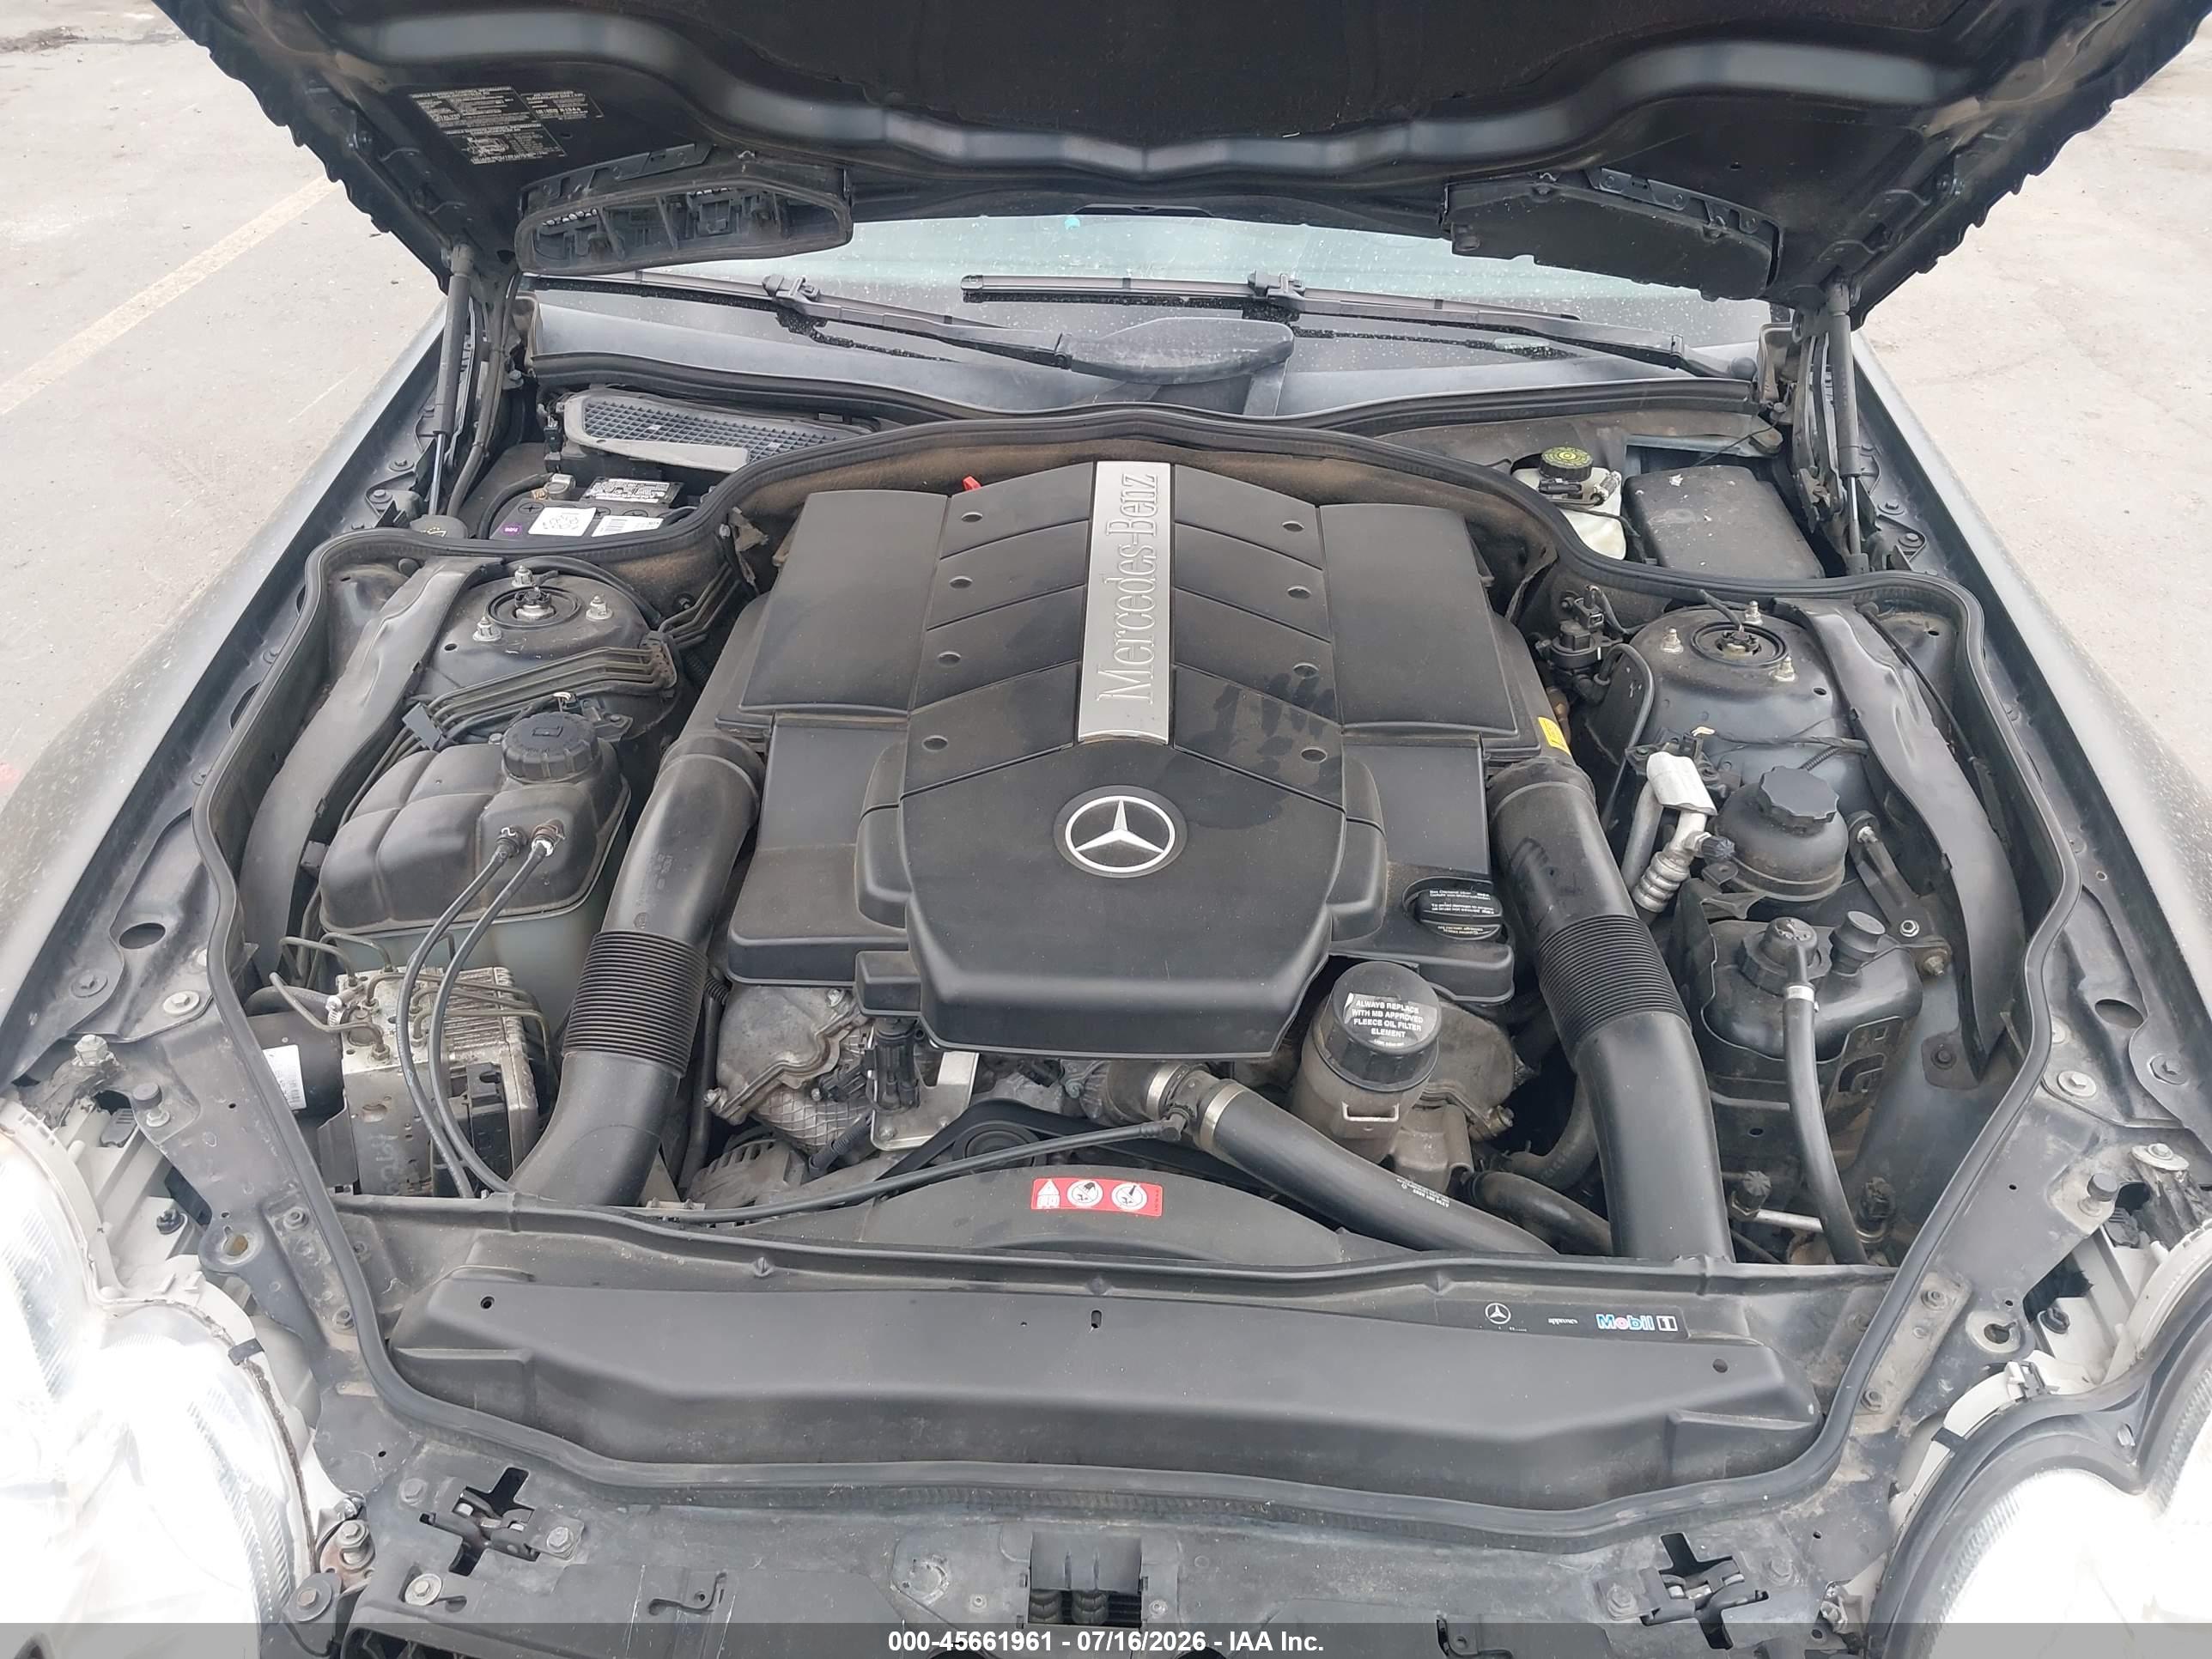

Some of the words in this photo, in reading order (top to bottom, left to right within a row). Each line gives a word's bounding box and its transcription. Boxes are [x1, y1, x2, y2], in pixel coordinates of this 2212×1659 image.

[1096, 473, 1158, 704] Mercedes-Benz
[1356, 1000, 1385, 1009] ALWAYS
[1387, 1002, 1419, 1013] REPLACE
[1352, 1008, 1370, 1017] WITH
[1385, 1012, 1424, 1024] APPROVED
[1353, 1018, 1382, 1026] FLEECE
[1398, 1021, 1422, 1031] FILTER
[1371, 1028, 1406, 1038] ELEMENT
[1595, 1314, 1655, 1331] Mobil
